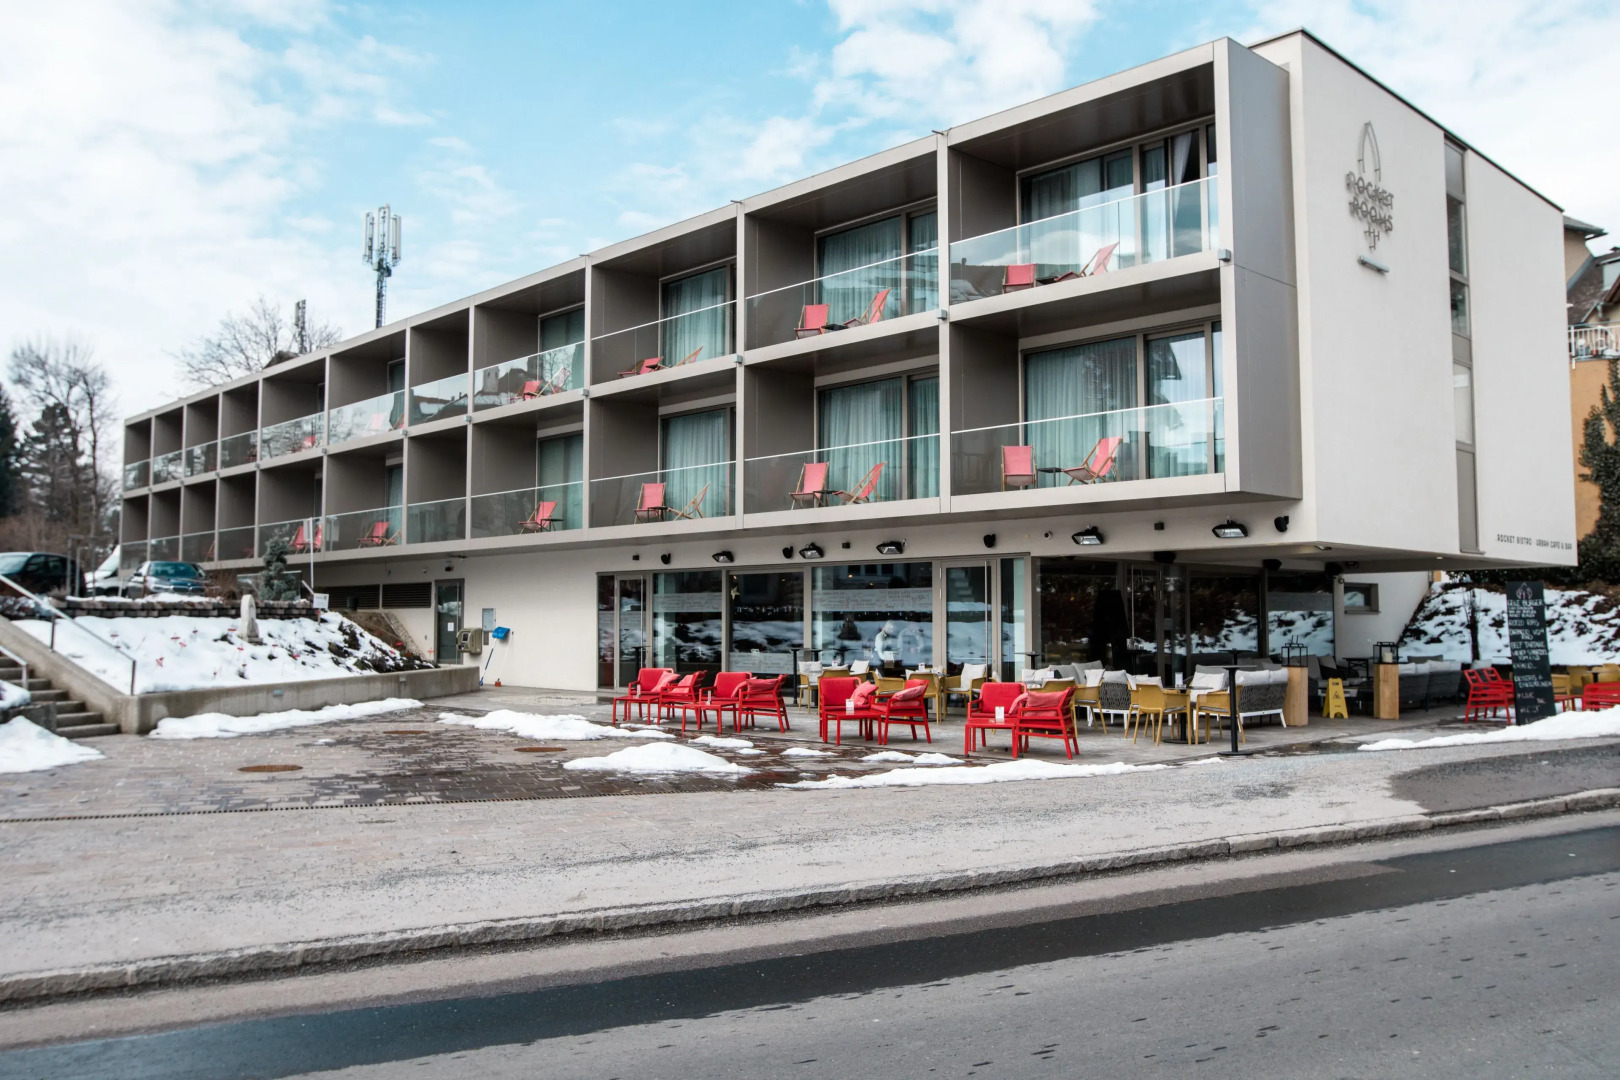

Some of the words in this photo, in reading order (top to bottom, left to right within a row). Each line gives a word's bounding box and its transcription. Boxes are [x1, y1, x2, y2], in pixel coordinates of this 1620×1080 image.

[1346, 171, 1394, 210] ROCKET
[1349, 196, 1393, 232] ROOMS
[1497, 533, 1515, 544] ROCKET
[1516, 536, 1532, 546] BISTRO
